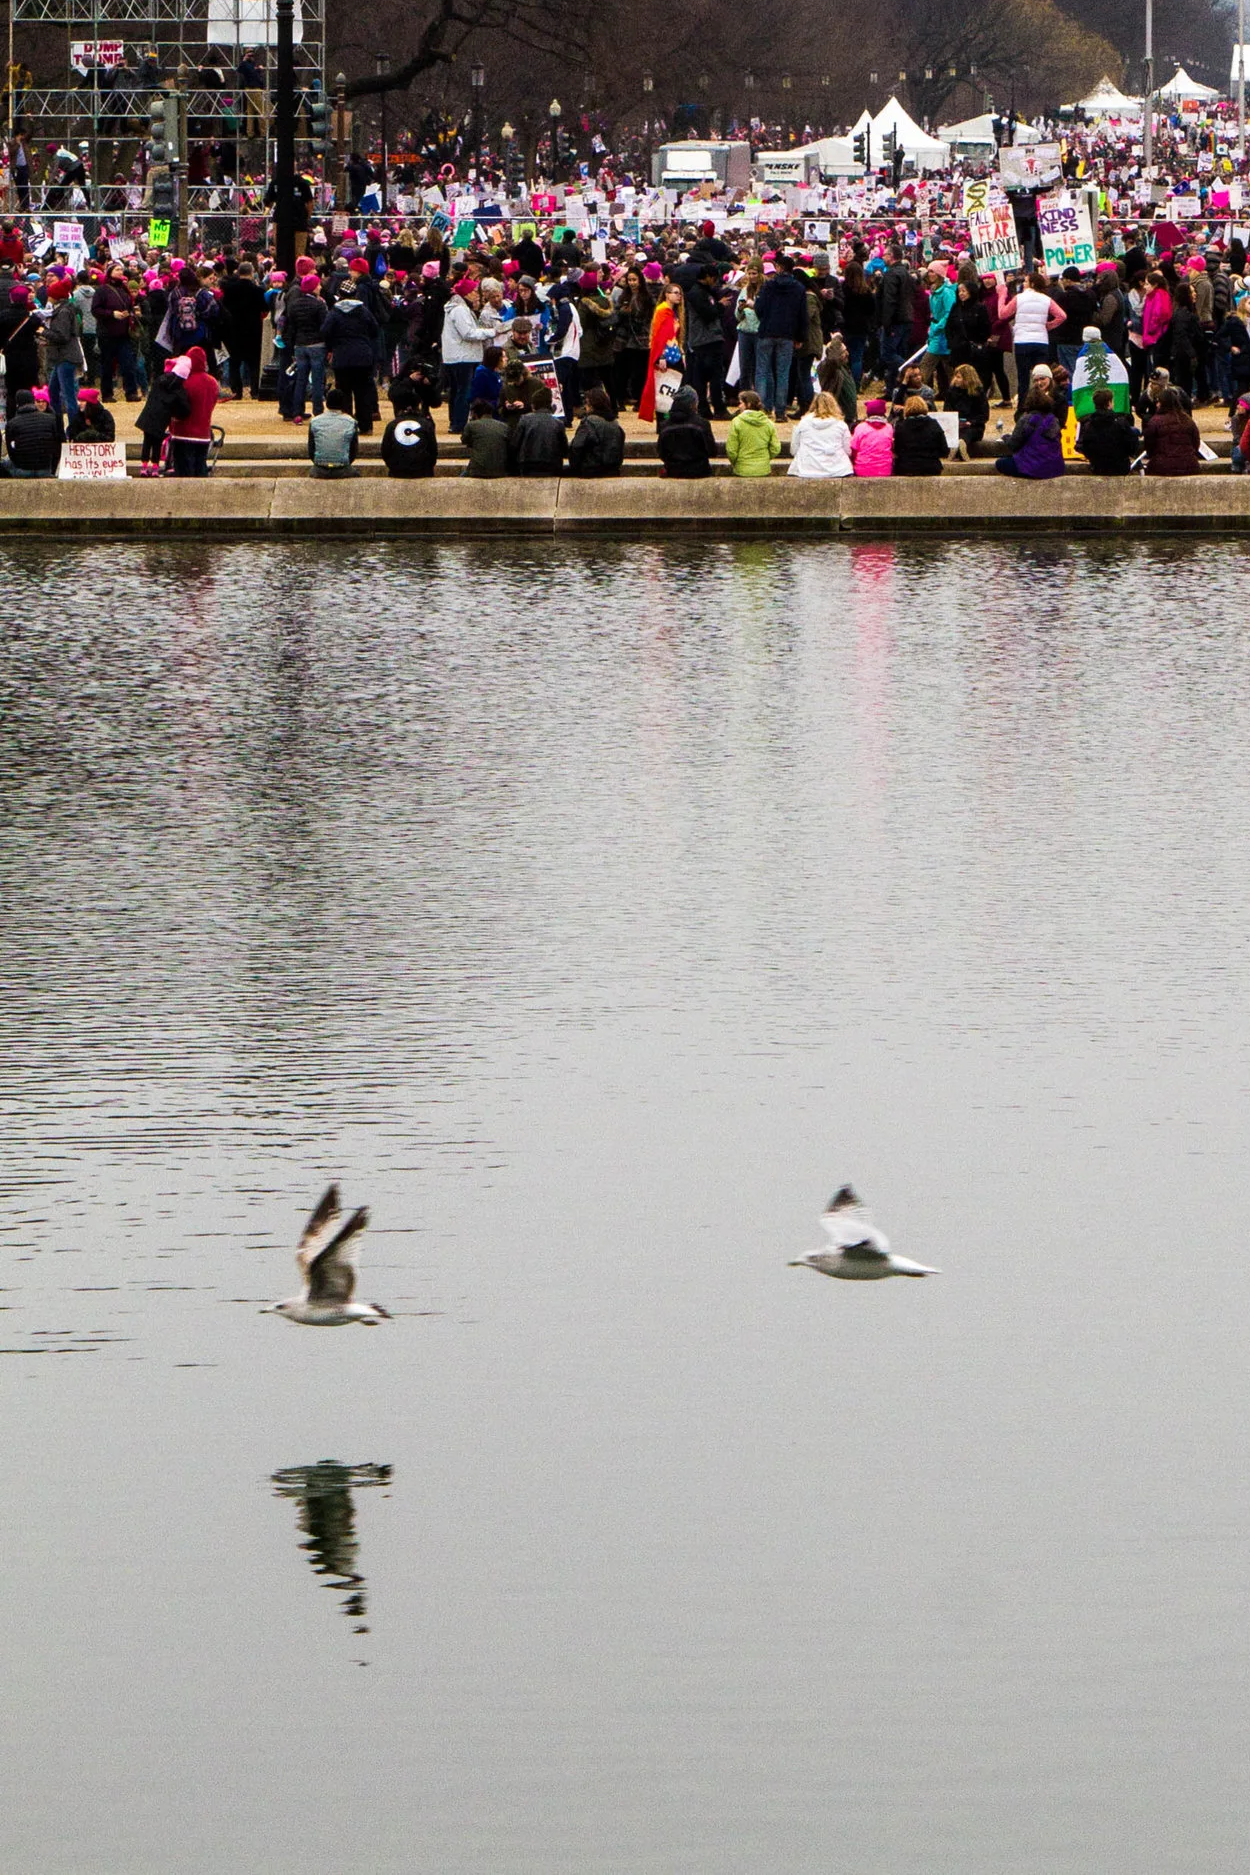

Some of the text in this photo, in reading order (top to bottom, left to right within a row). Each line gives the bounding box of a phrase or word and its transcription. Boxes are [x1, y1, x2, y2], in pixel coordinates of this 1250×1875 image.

[73, 54, 122, 65] TUMP
[977, 222, 1010, 242] FEAR
[1041, 219, 1079, 235] NESS
[1045, 244, 1094, 268] POWER
[69, 444, 116, 456] HERSTORY
[65, 457, 124, 472] has its eyes
